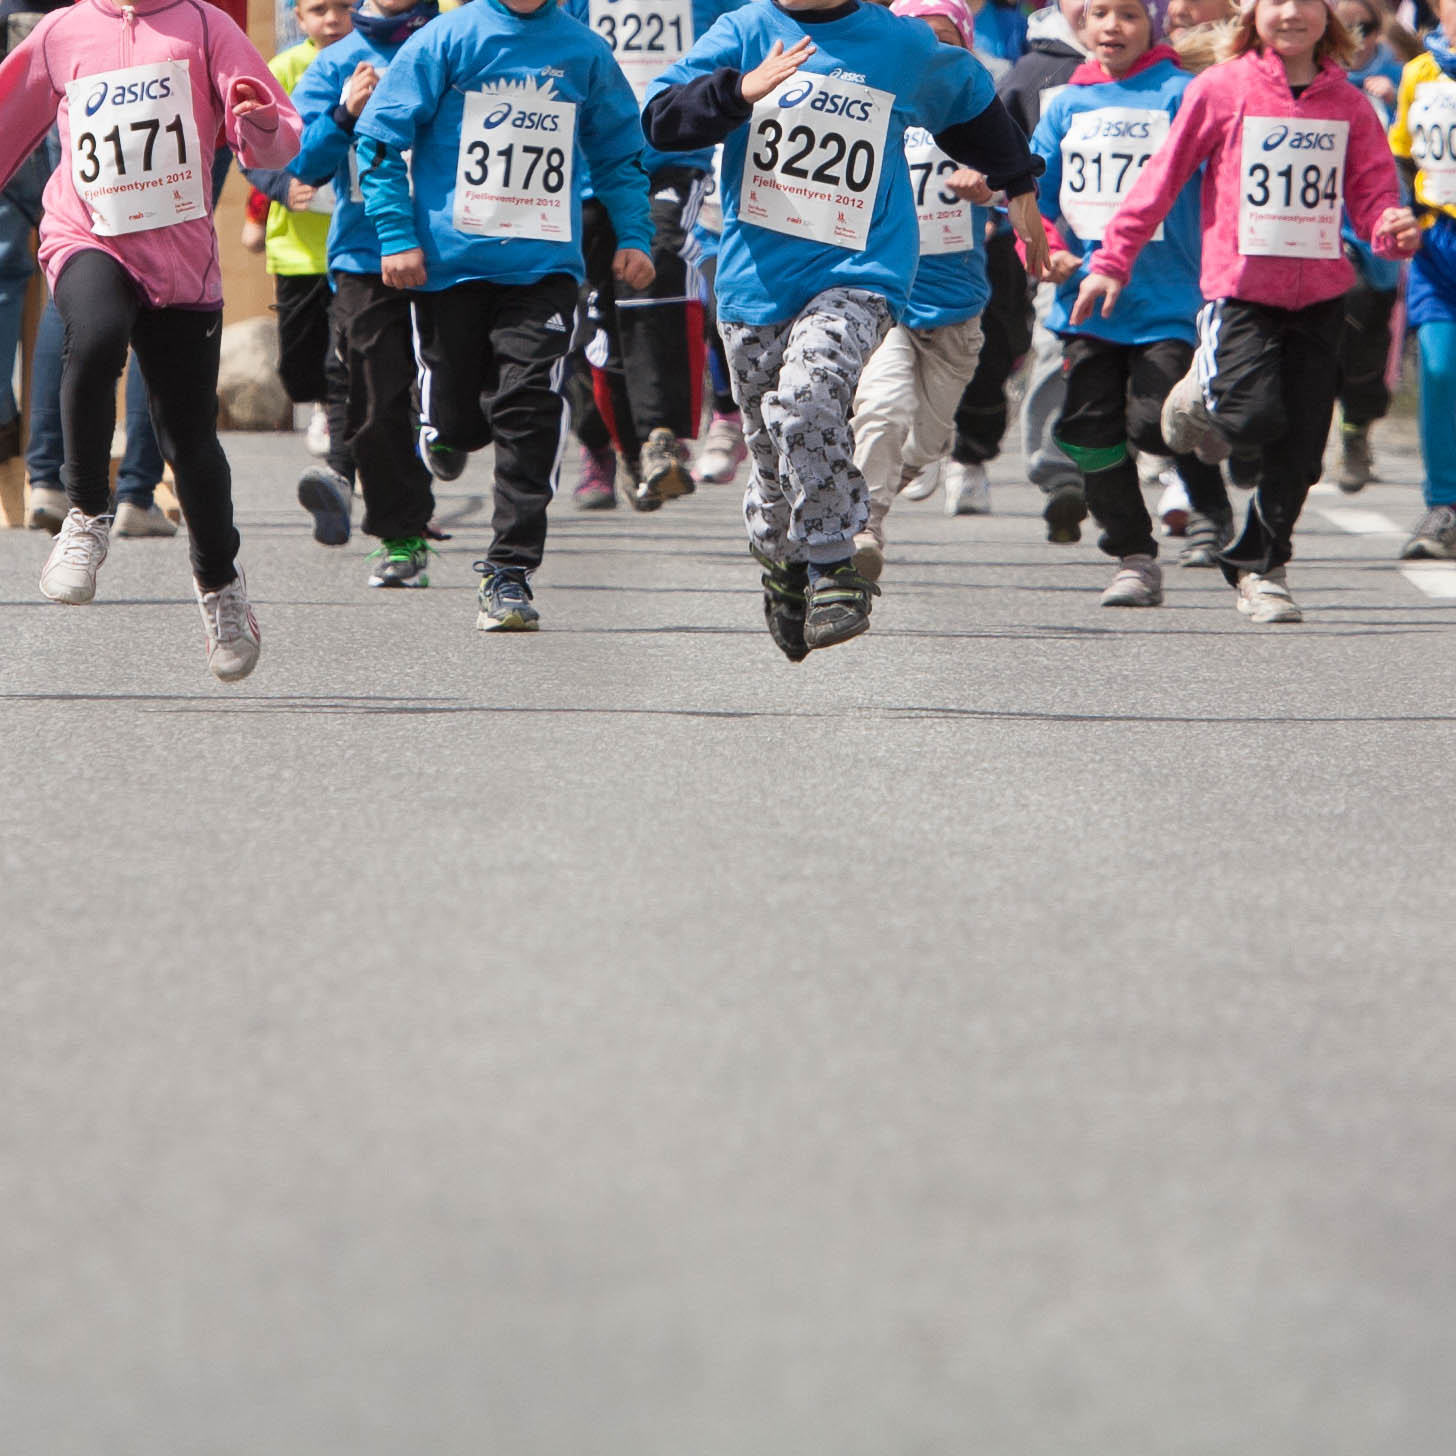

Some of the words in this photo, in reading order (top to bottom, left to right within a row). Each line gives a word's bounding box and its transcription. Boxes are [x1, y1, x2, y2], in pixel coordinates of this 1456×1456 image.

[597, 12, 682, 52] 3221
[111, 76, 172, 106] asics
[810, 90, 873, 122] asics
[512, 110, 560, 132] asics
[77, 114, 187, 183] 3171
[752, 118, 875, 193] 3220
[1289, 132, 1336, 151] asics
[84, 178, 164, 200] Fjelleventyret
[166, 170, 193, 184] 2012
[464, 140, 565, 194] 3178
[910, 159, 961, 206] 73
[1069, 152, 1152, 193] 317
[466, 190, 534, 206] Fjelleventyret
[535, 198, 561, 208] 2012
[752, 175, 832, 202] Fjelleventyret
[834, 193, 864, 209] 2012
[1247, 163, 1337, 209] 3184
